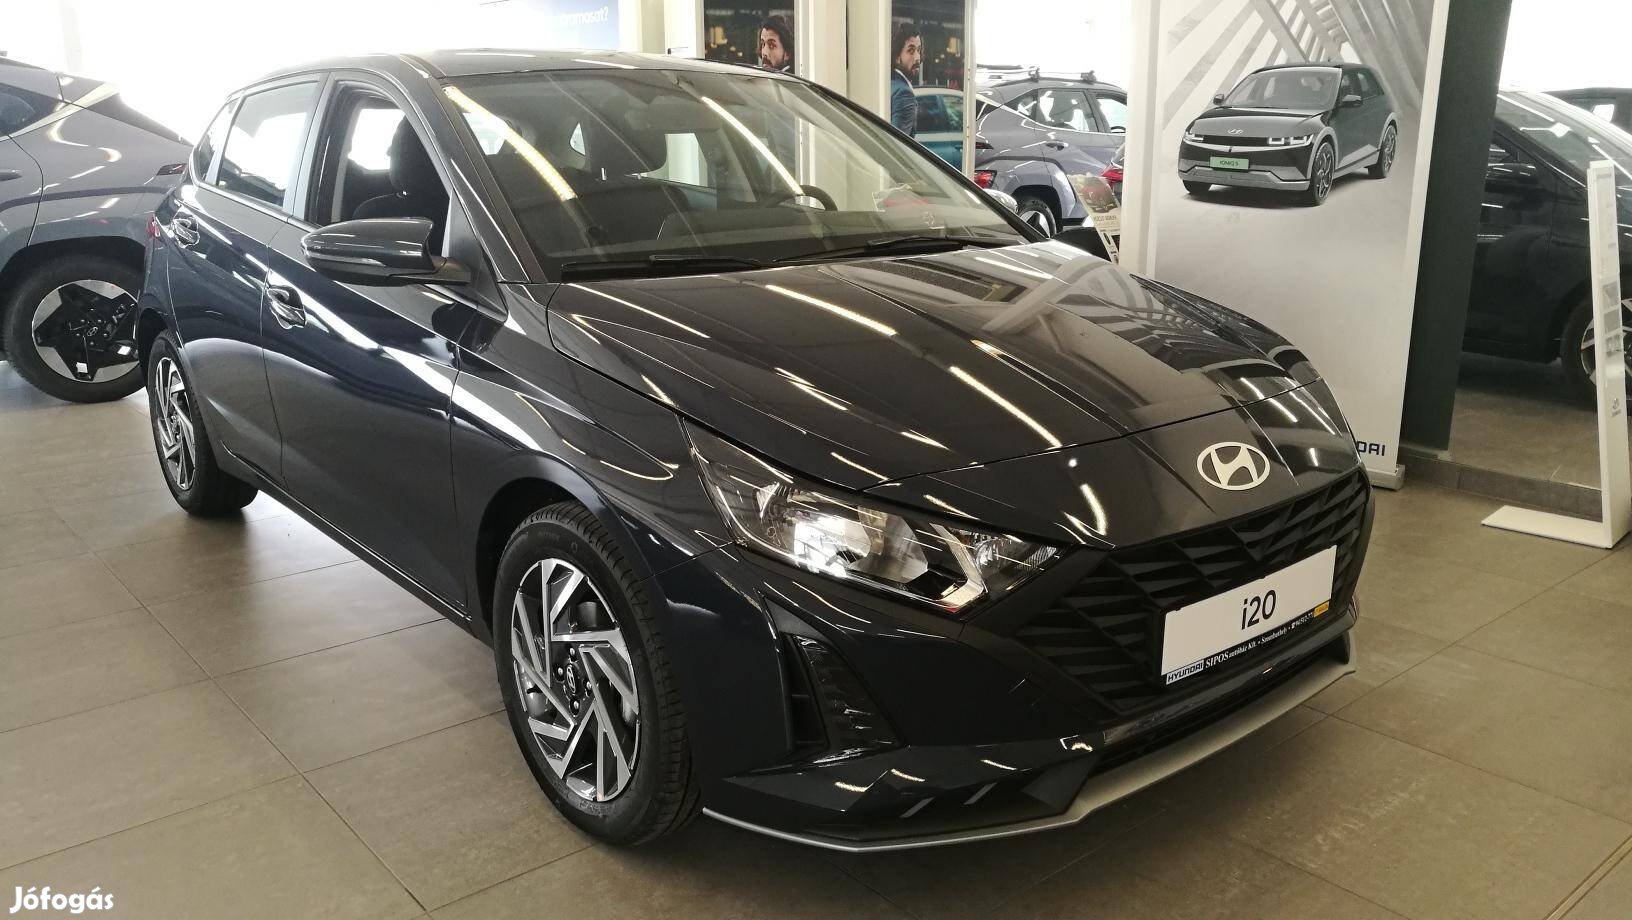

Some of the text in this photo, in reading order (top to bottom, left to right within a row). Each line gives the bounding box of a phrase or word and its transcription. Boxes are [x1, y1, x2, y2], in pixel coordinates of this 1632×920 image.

[1241, 589, 1277, 630] i20
[1167, 663, 1203, 681] HYUNDAI
[1205, 651, 1229, 669] SIPOS
